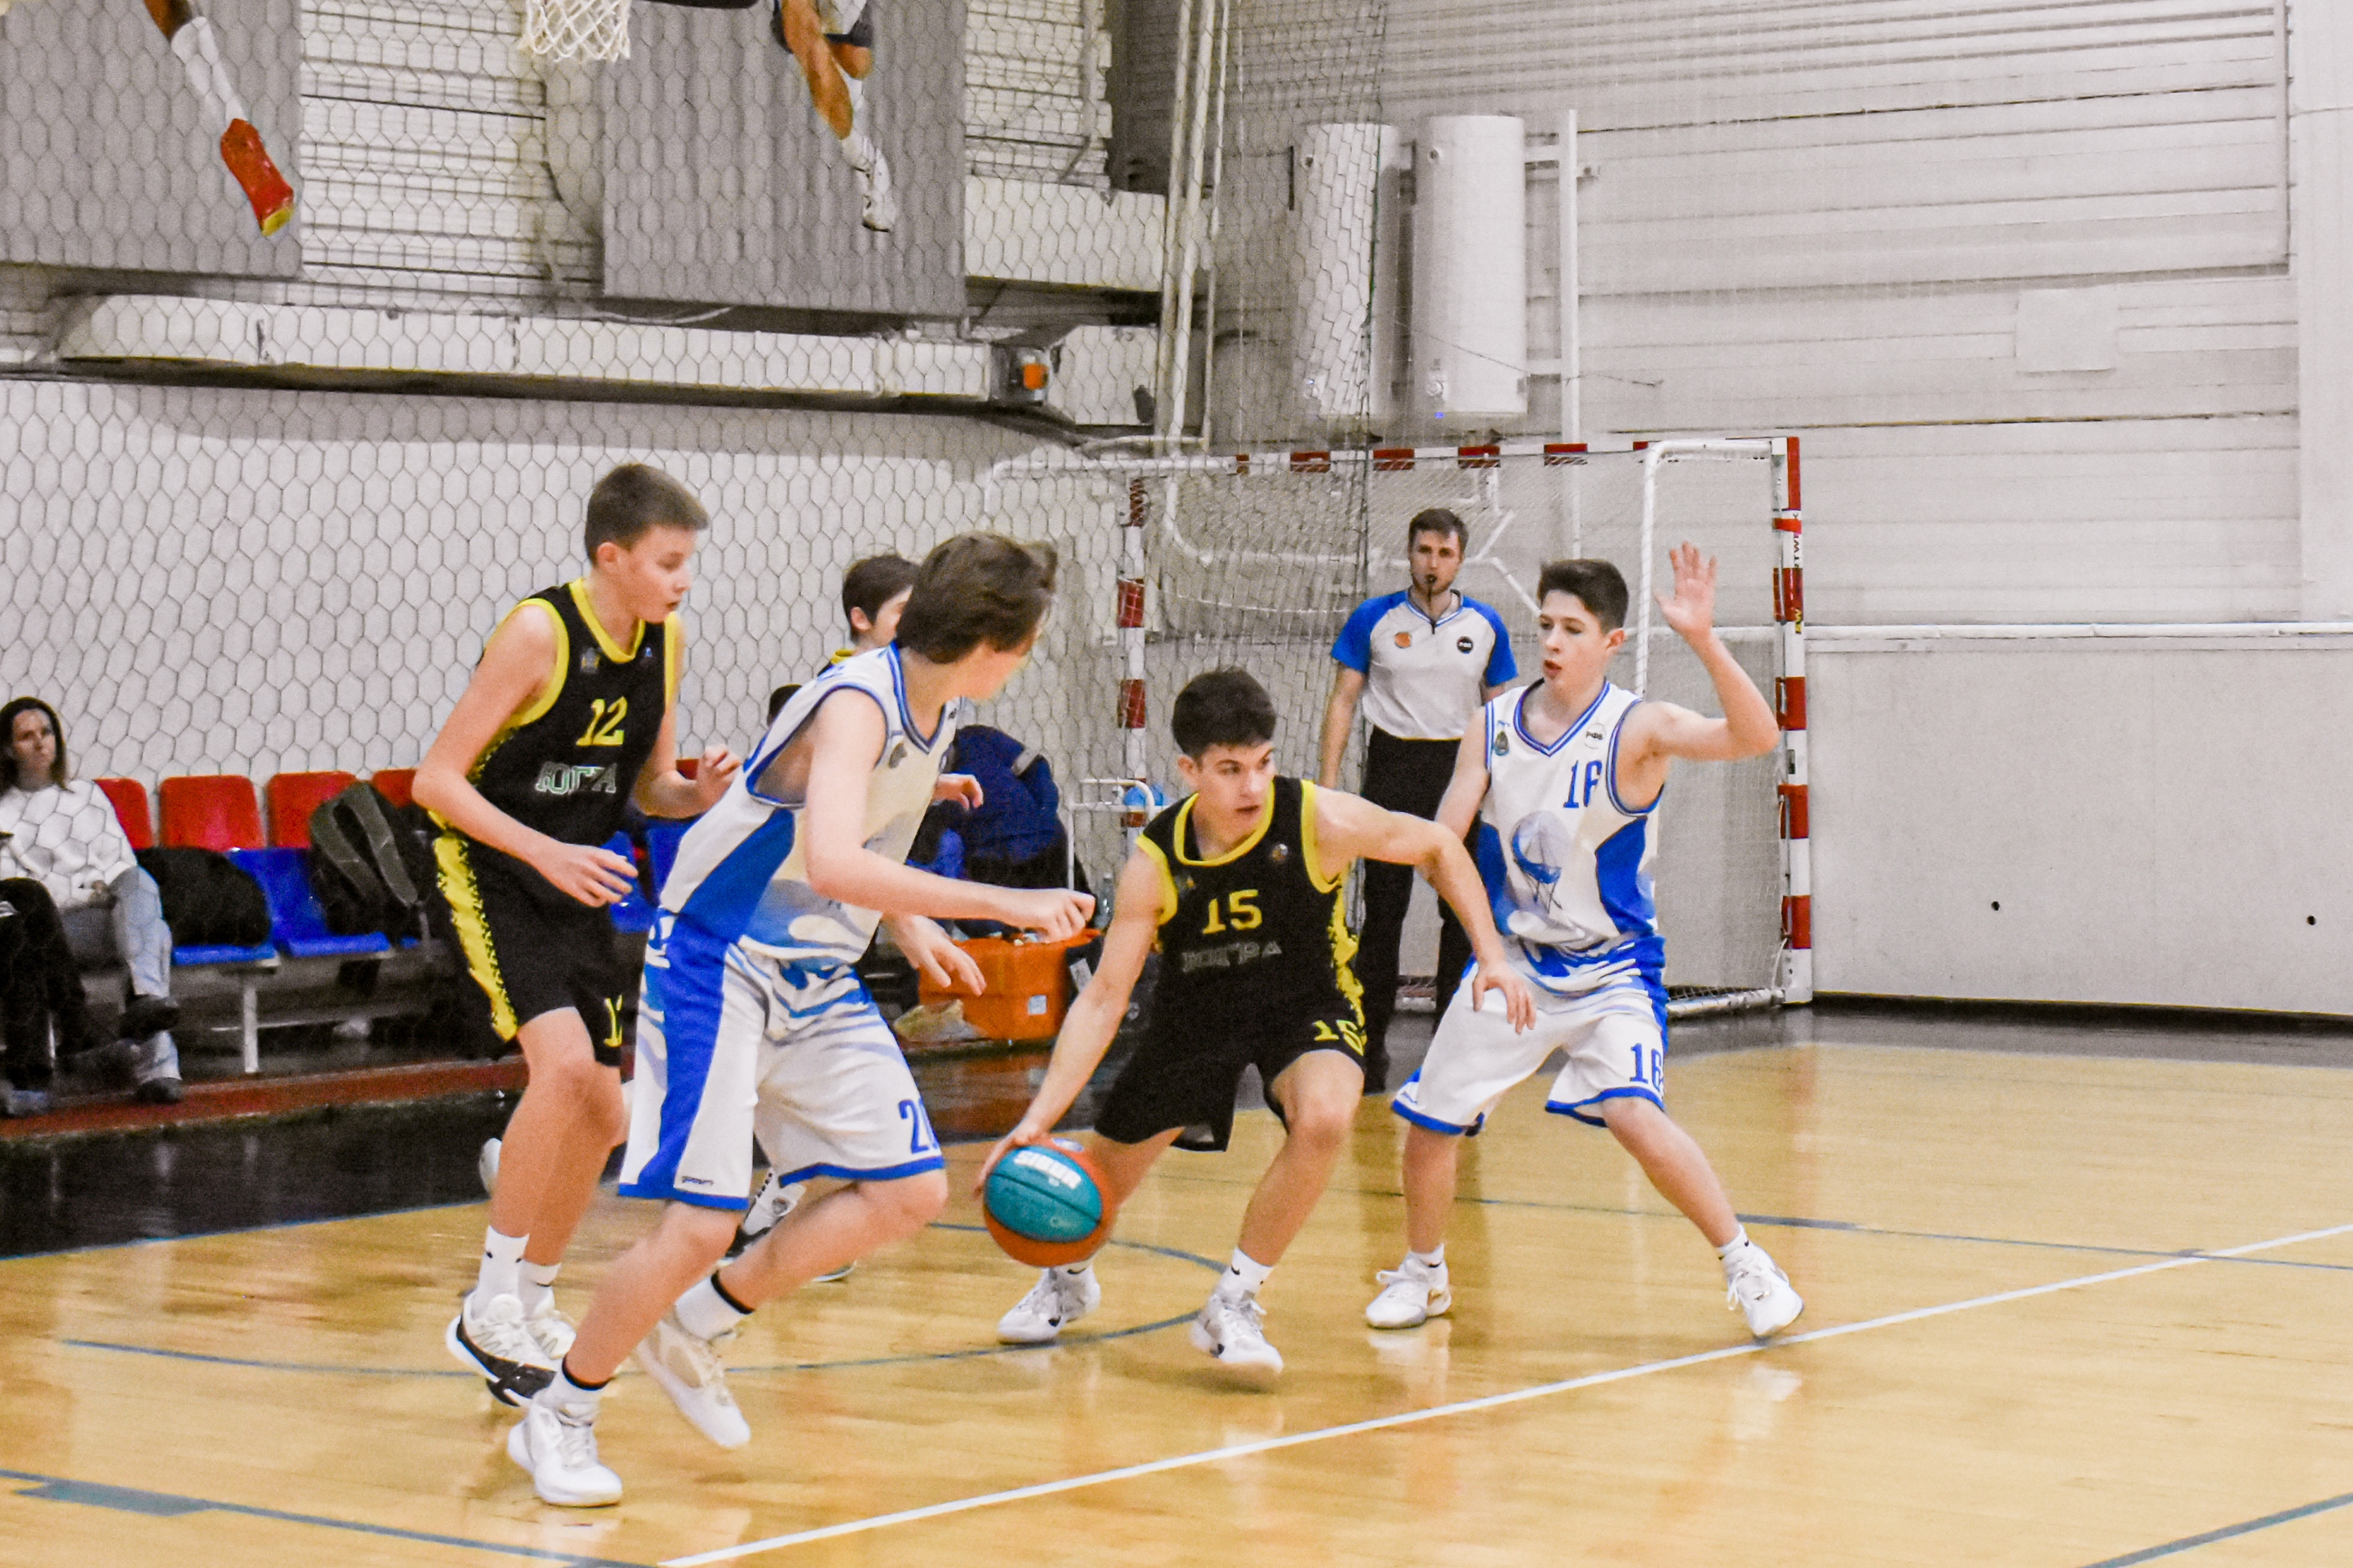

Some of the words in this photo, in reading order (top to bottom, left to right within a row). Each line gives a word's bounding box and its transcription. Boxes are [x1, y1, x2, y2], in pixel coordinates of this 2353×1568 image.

[576, 695, 628, 746] 12
[1202, 889, 1263, 935] 15
[1312, 1020, 1367, 1056] 15
[1630, 1043, 1664, 1093] 16
[1013, 1150, 1082, 1191] SIBUR
